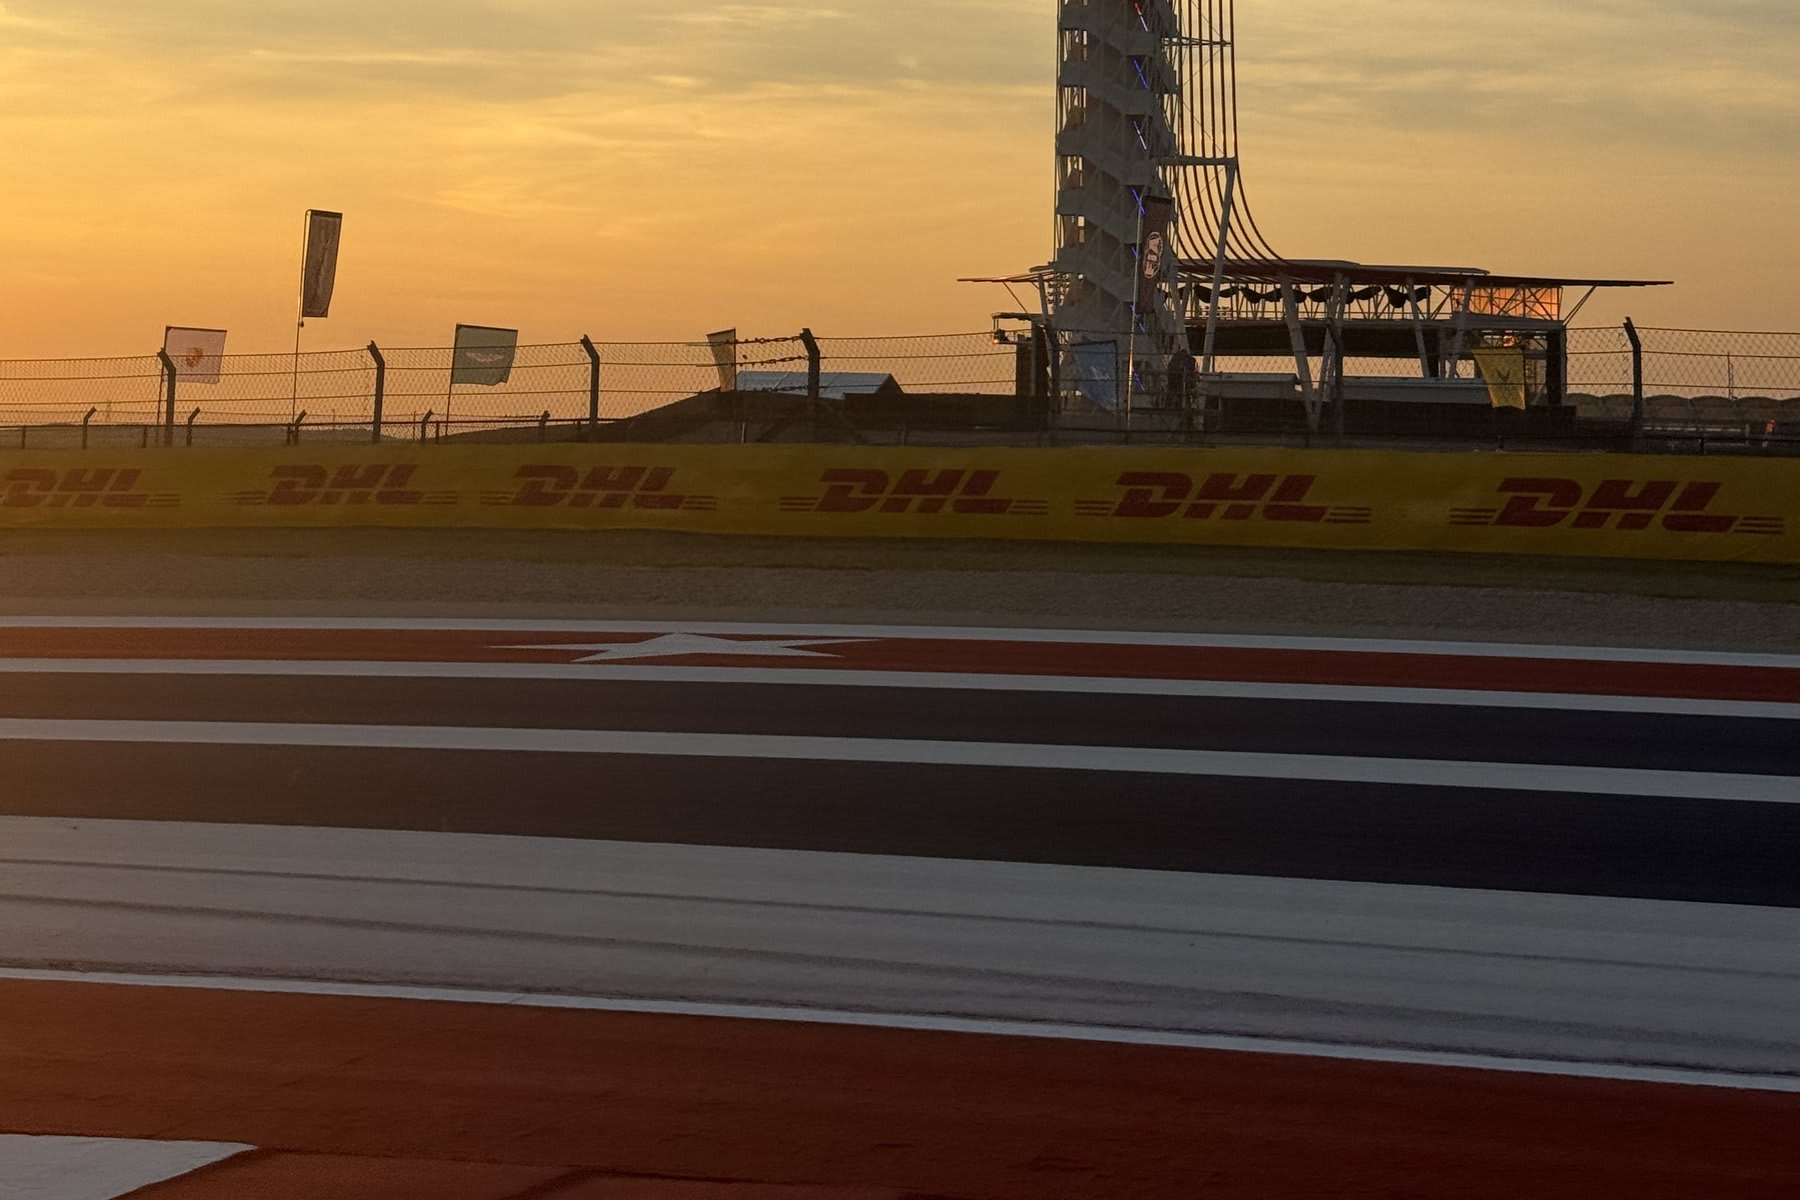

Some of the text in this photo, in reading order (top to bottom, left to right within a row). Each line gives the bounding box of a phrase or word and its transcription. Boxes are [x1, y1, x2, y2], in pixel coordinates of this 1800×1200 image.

[0, 468, 149, 508] DHL
[266, 464, 421, 505] DHL
[513, 464, 687, 510] DHL
[813, 469, 1013, 514] DHL
[1109, 471, 1327, 523] DHL
[1490, 477, 1738, 533] DHL
